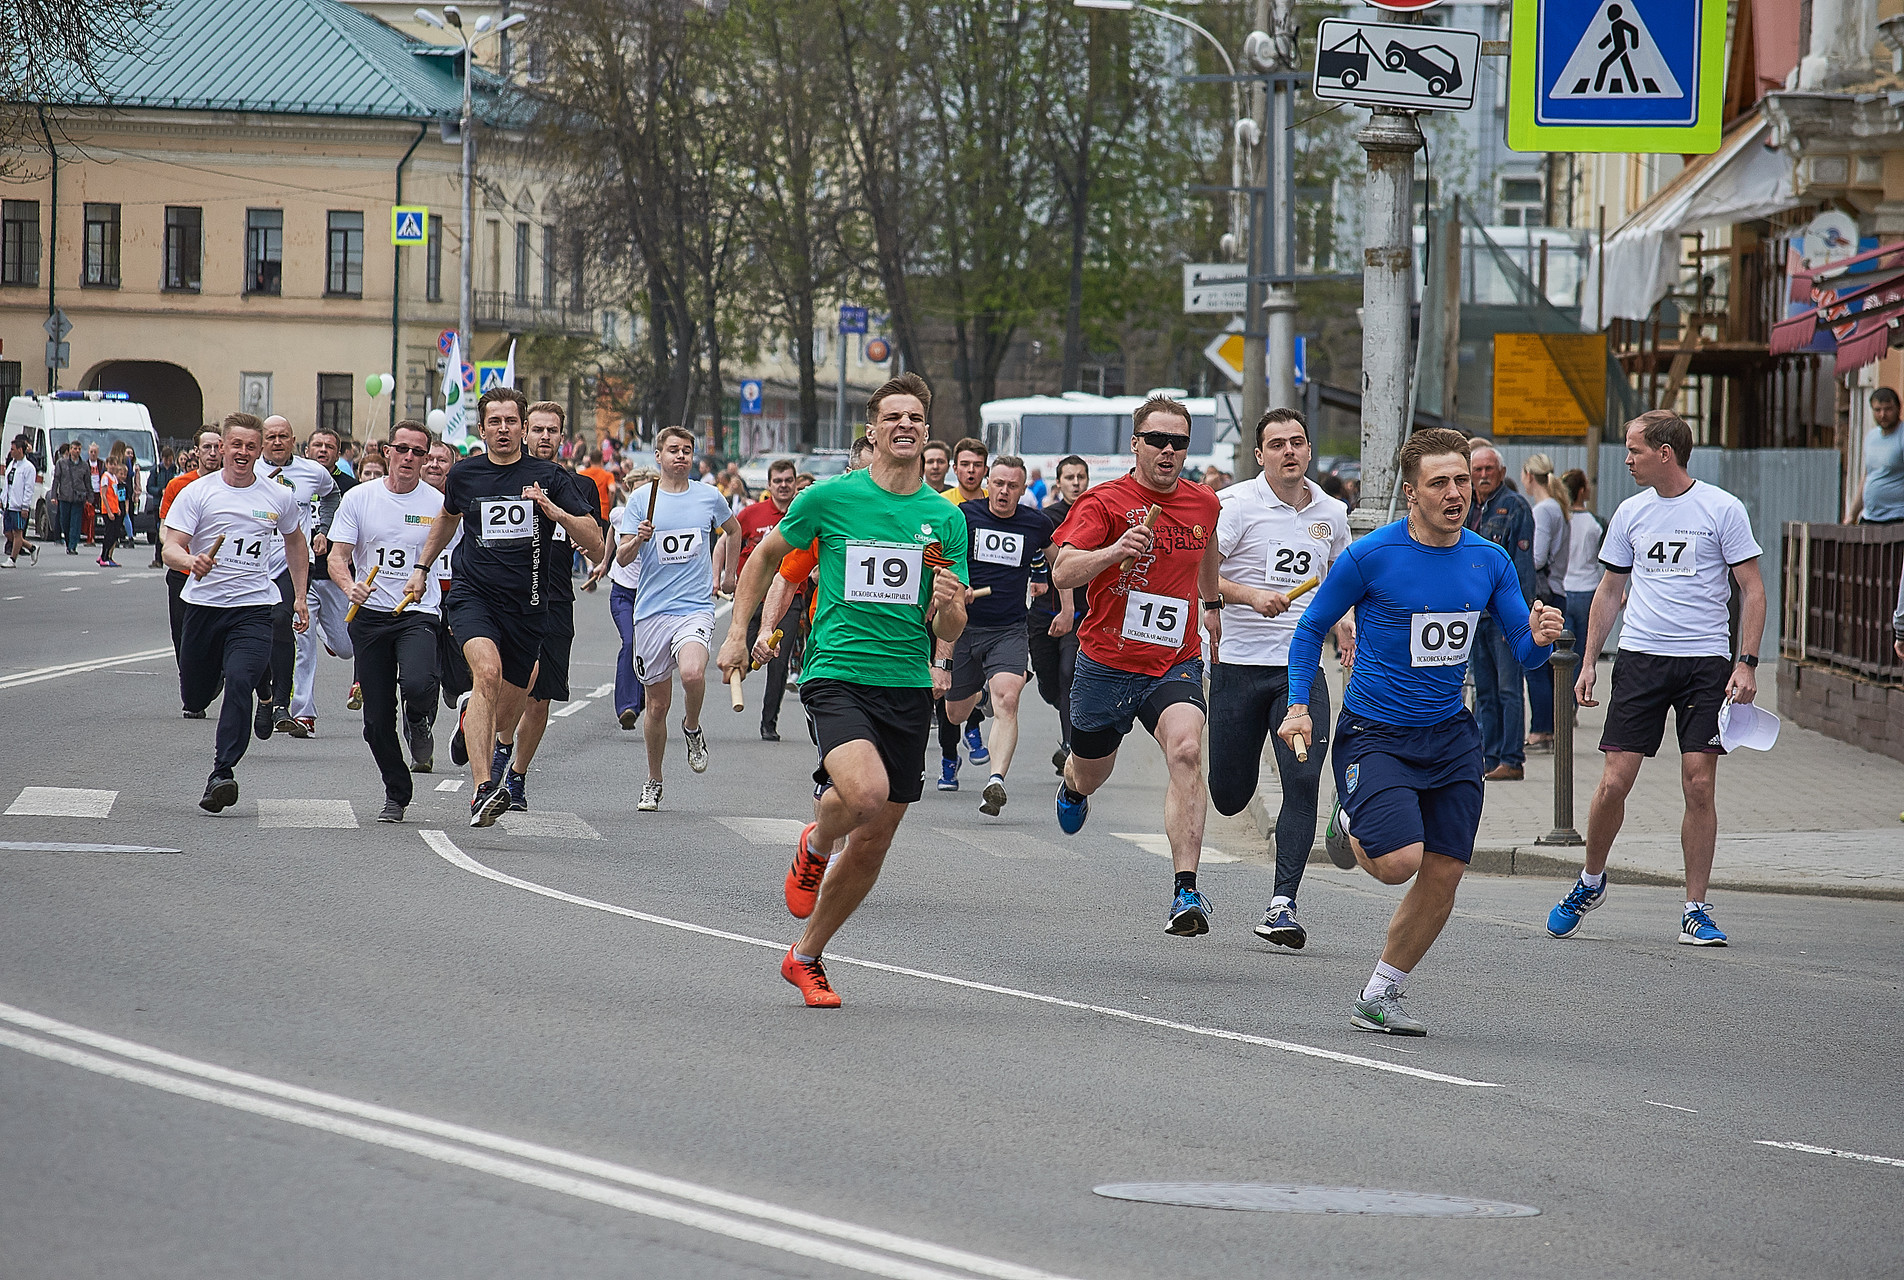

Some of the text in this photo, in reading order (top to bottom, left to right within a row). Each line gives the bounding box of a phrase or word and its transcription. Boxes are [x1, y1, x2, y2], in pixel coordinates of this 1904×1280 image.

[489, 505, 525, 525] 20
[233, 537, 262, 559] 14
[663, 534, 695, 554] 07
[986, 534, 1016, 553] 06
[1647, 541, 1688, 564] 47
[376, 547, 406, 569] 13
[1274, 548, 1312, 576] 23
[860, 557, 909, 588] 19
[851, 590, 885, 598] ПСКОВСКАЯ
[1139, 602, 1178, 632] 15
[1421, 621, 1469, 651] 09
